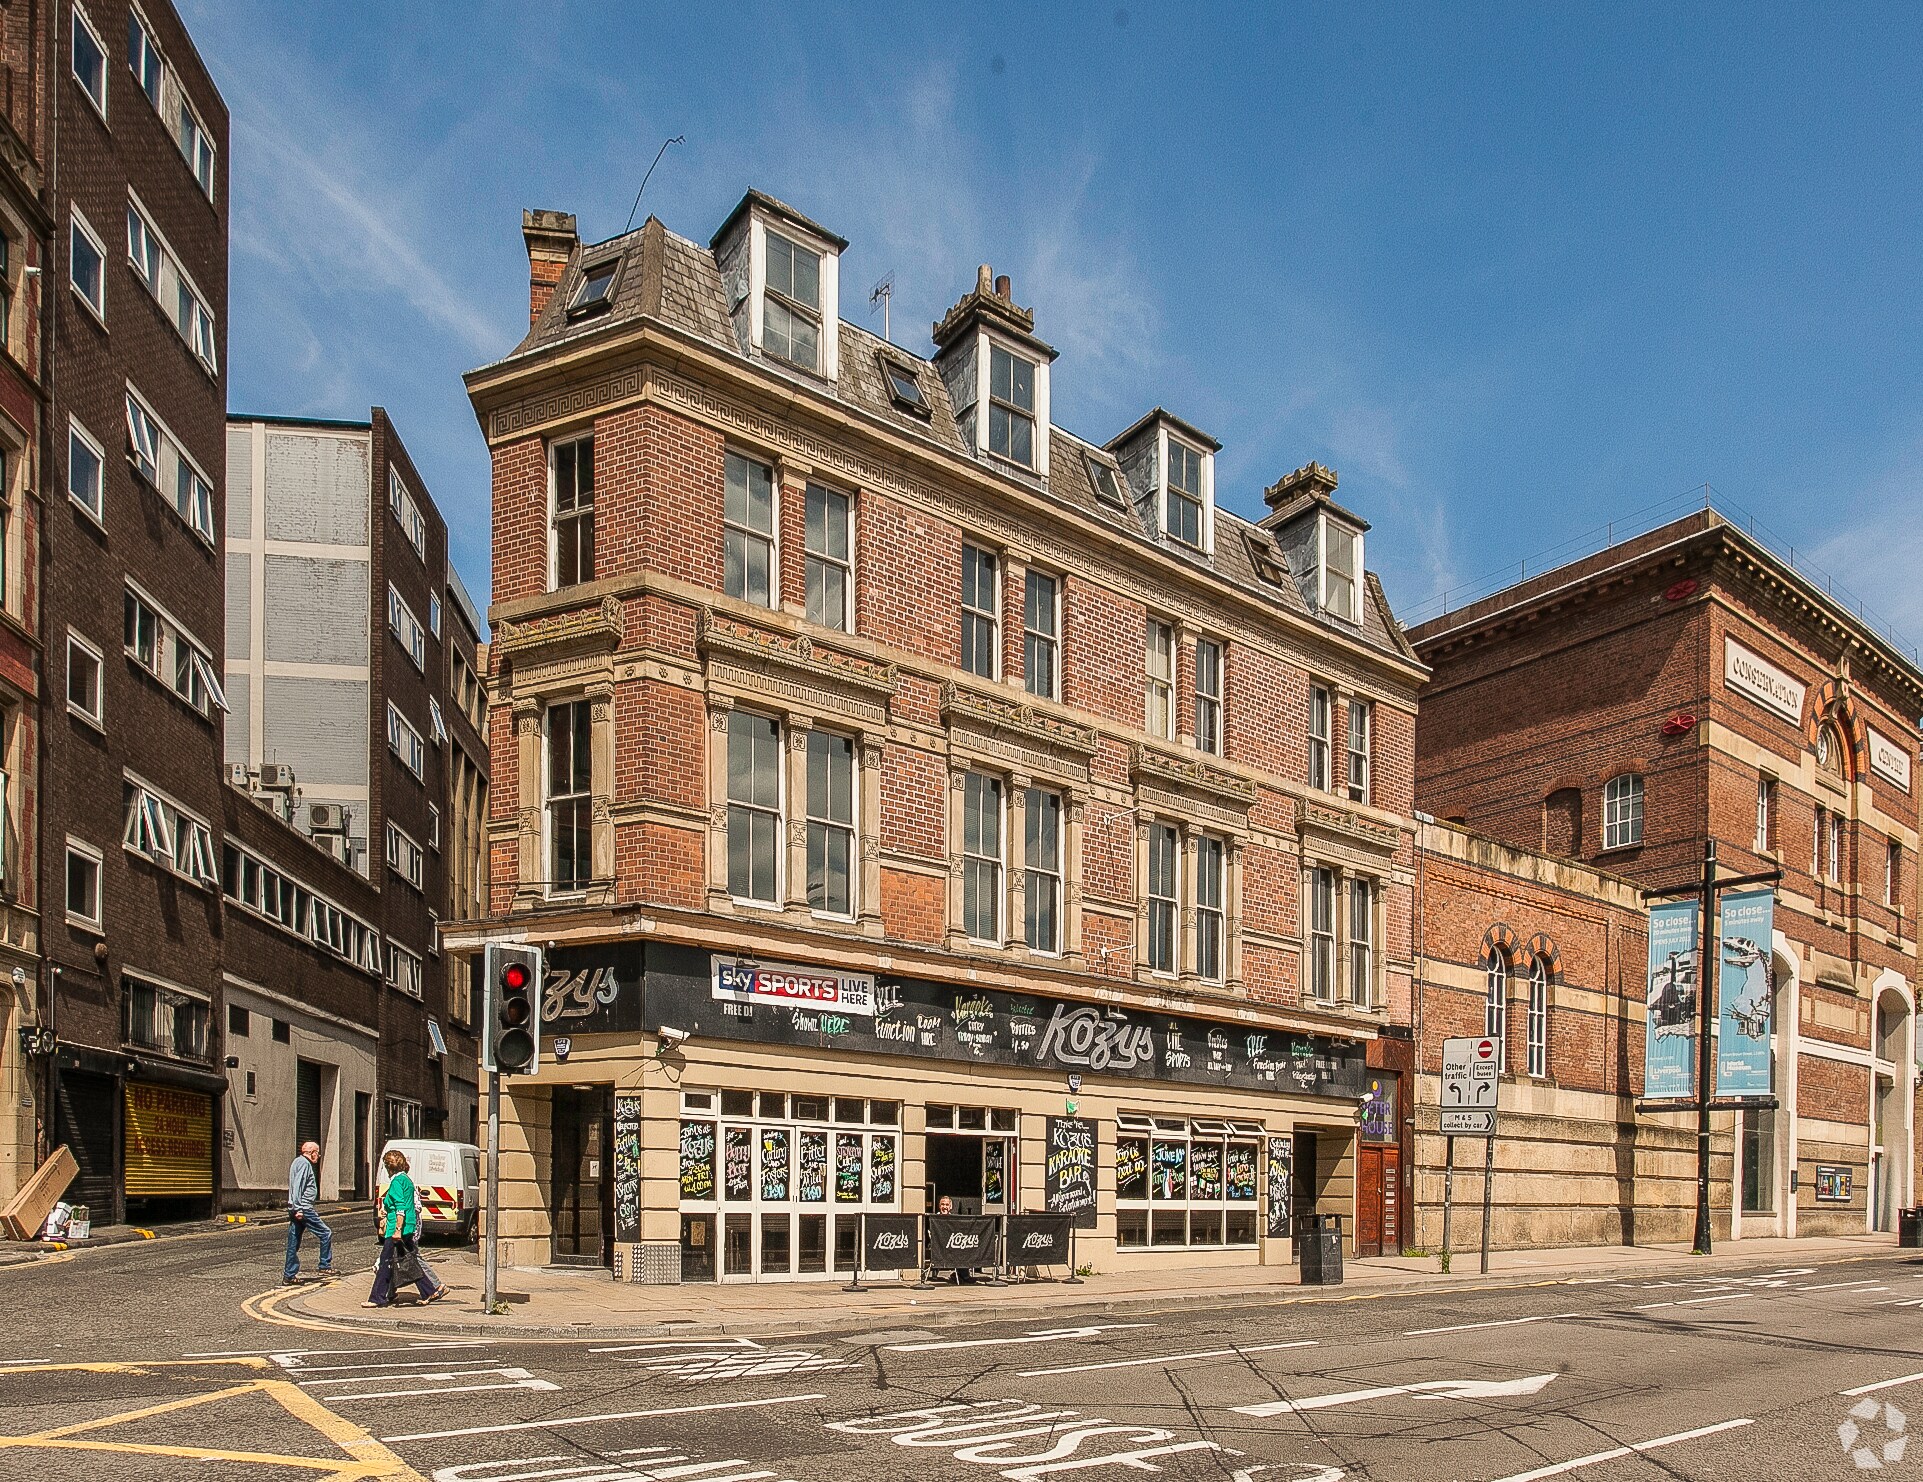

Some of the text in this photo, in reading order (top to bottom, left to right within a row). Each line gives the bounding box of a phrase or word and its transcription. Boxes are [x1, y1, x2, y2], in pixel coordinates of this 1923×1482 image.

[1733, 655, 1799, 709] CONSERVATION
[1878, 747, 1904, 776] CENTRE
[1724, 908, 1736, 919] So
[1728, 918, 1749, 926] minutes
[1749, 916, 1764, 924] away
[1653, 918, 1664, 929] So
[1660, 927, 1680, 935] minutes
[758, 973, 835, 999] SPORTS
[841, 978, 868, 994] LIVE
[841, 994, 868, 1006] HERE
[723, 1003, 743, 1016] FREE
[820, 1014, 850, 1034] HERE
[1036, 1003, 1154, 1070] Kozys
[1444, 1071, 1468, 1080] traffic
[1445, 1063, 1467, 1071] Other
[1653, 1066, 1682, 1076] Liverpool
[133, 1086, 206, 1117] NO PARKING
[167, 1117, 188, 1136] HOUR
[1362, 1121, 1394, 1135] HOUSE
[1048, 1147, 1095, 1177] KARAOKE
[1060, 1165, 1082, 1189] BAR
[873, 1229, 909, 1250] Kozys
[945, 1232, 979, 1250] Kozys
[1022, 1231, 1053, 1249] Kozys
[268, 1343, 563, 1401] LEFT
